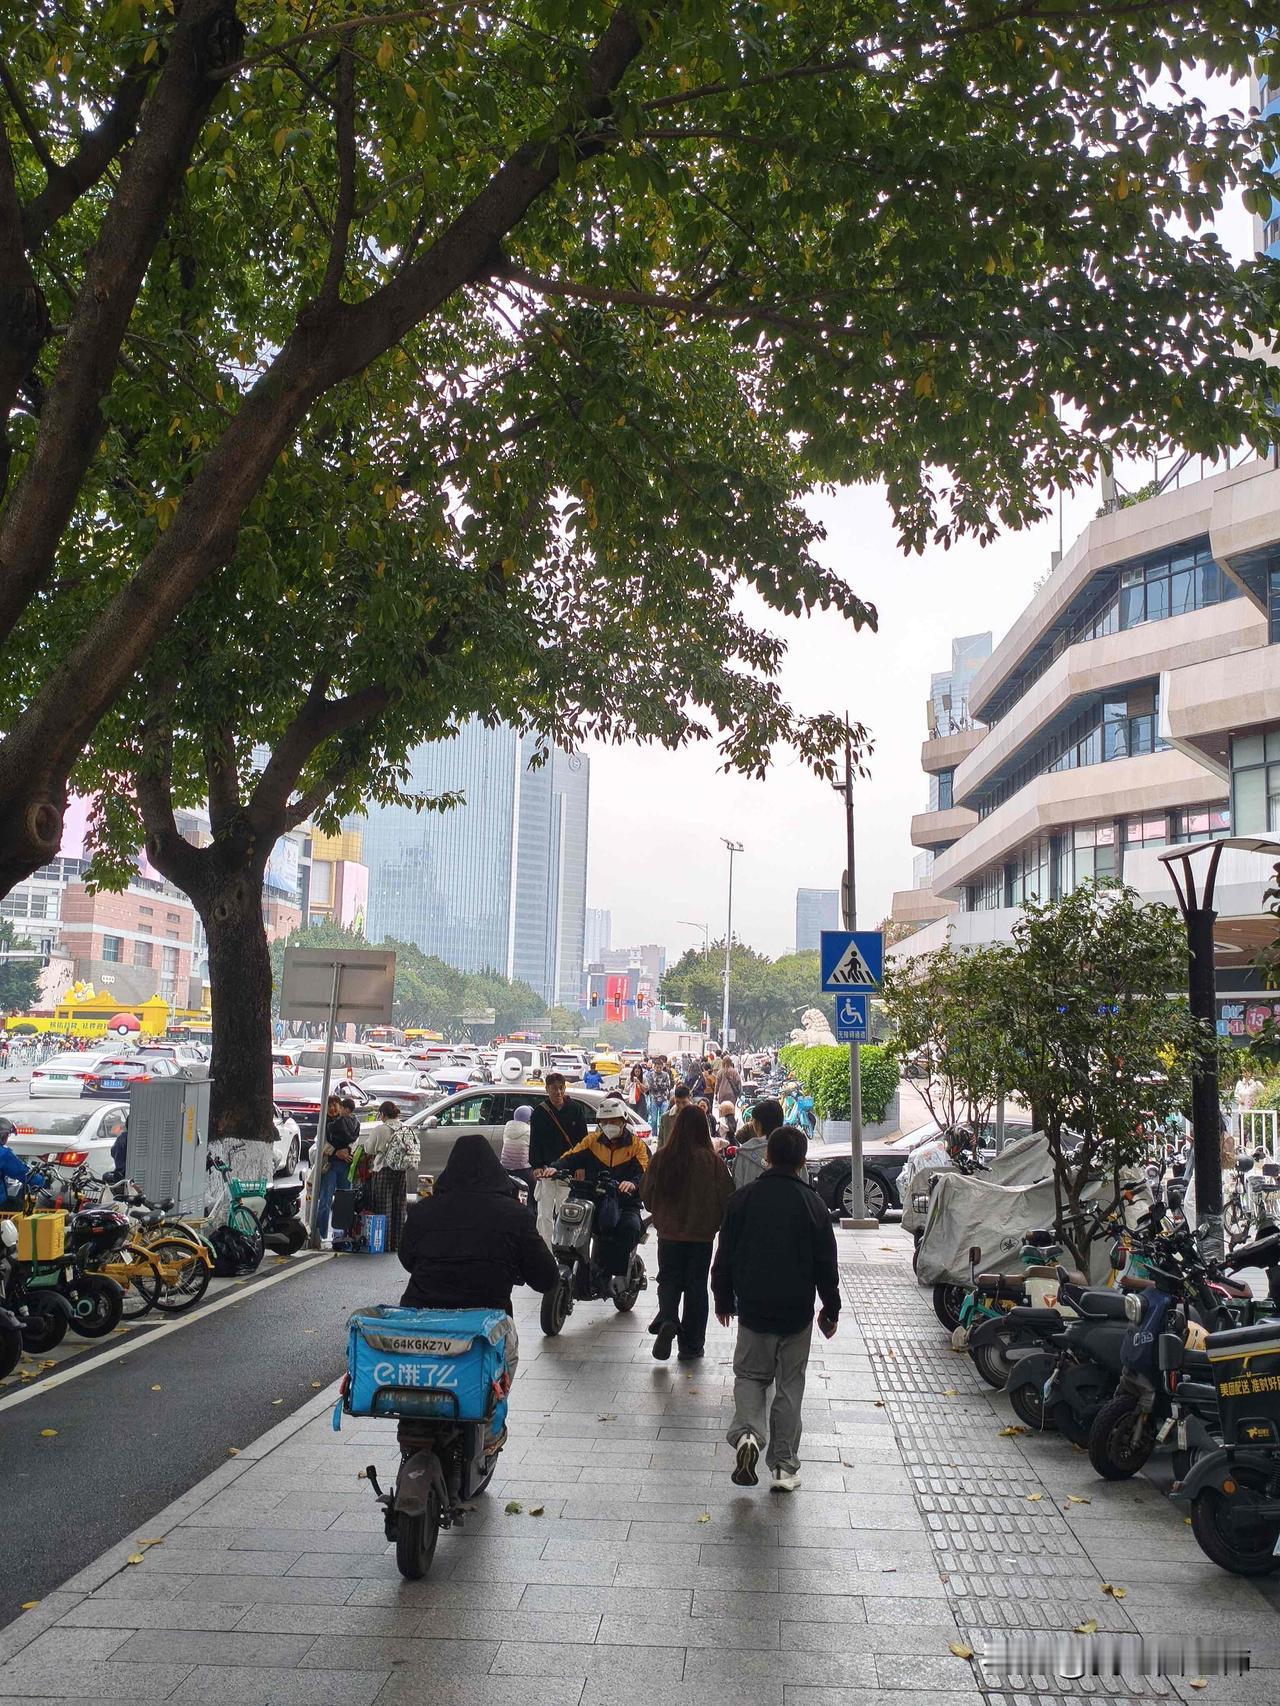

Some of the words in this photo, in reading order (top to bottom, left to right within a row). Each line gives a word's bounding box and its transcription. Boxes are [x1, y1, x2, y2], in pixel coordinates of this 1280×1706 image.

[393, 1339, 452, 1351] 64KGKZ7V
[1220, 1380, 1250, 1397] 美团配送
[1251, 1375, 1280, 1392] 准时好
